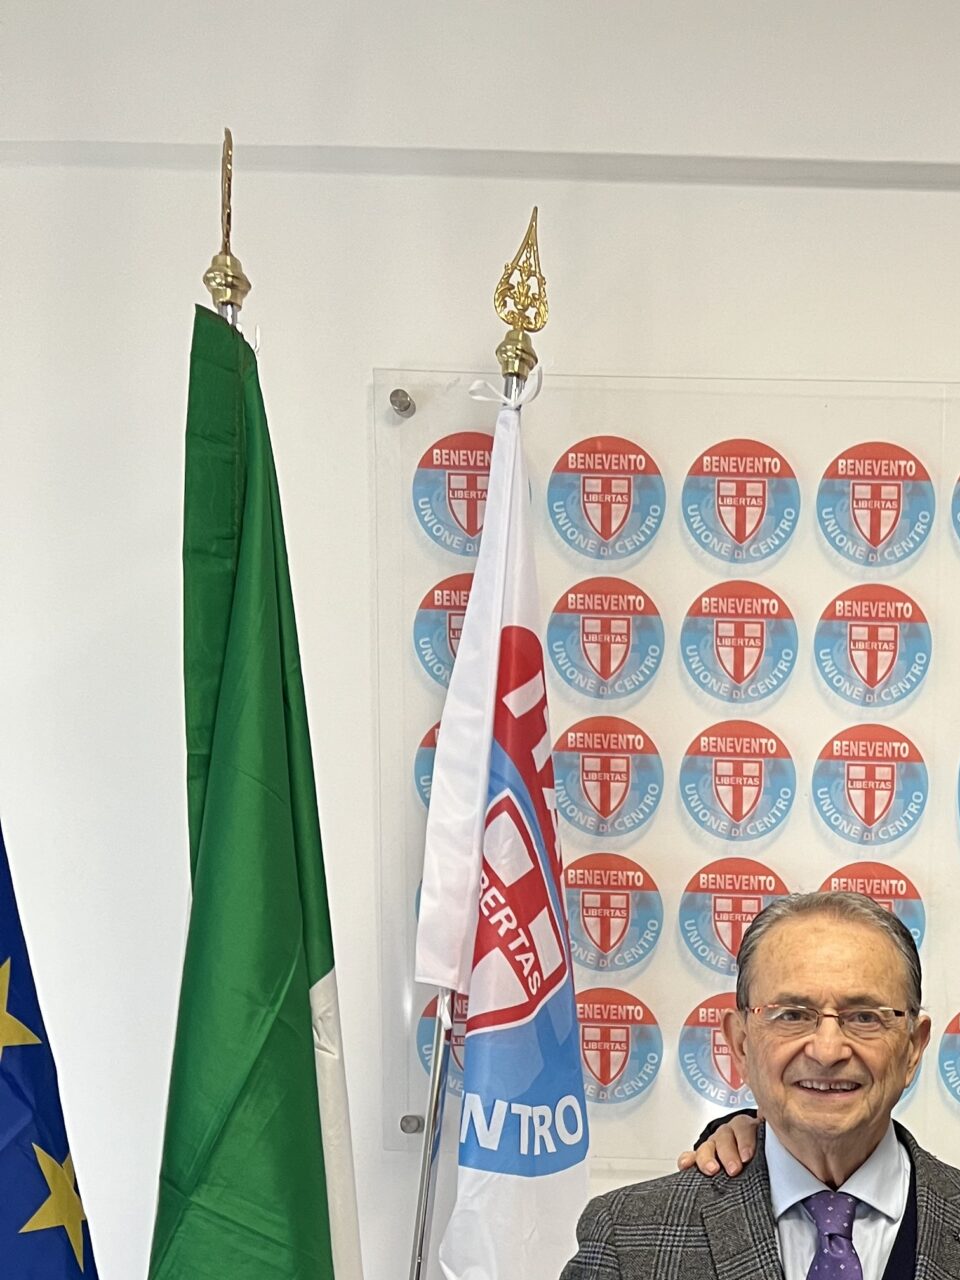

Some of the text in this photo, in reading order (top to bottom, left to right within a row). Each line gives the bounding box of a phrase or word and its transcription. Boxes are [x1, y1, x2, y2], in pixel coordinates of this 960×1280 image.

[433, 449, 493, 466] BENEVEN
[567, 453, 646, 471] BENEVENTO
[702, 456, 781, 474] BENEVENTO
[837, 459, 916, 477] BENEVENTO
[449, 490, 488, 499] LIBERTA
[583, 493, 629, 503] LIBERTAS
[717, 496, 763, 507] LIBERTAS
[852, 499, 898, 510] LIBERTAS
[553, 501, 597, 552] UNIONE
[615, 504, 661, 554] CENTRO
[822, 507, 865, 559] UNIONE
[883, 511, 930, 561] CENTRO
[567, 594, 644, 611] BENEVENTO
[701, 597, 779, 615] BENEVENTO
[835, 601, 913, 618] BENEVENTO
[583, 633, 628, 643] LIBERTAS
[716, 637, 761, 647] LIBERTAS
[850, 641, 895, 651] LIBERTAS
[686, 645, 729, 695] UNIONE
[747, 648, 793, 697] CENTRO
[567, 732, 644, 750] BENEVENTO
[699, 737, 777, 754] BENEVENTO
[832, 741, 909, 758] BENEVENTO
[583, 772, 627, 781] LIBERTAS
[715, 776, 760, 786] LIBERTAS
[847, 780, 892, 790] LIBERTAS
[817, 787, 860, 837] UNIONE
[878, 791, 924, 839] CENTRO
[567, 869, 644, 887] BENEVENTO
[699, 873, 776, 891] BENEVENTO
[831, 877, 907, 895] BENEVENTO
[583, 908, 627, 917] LIBERTAS
[577, 1004, 644, 1020] ENEVENTO
[583, 1042, 627, 1051] LIBERTAS
[460, 1090, 584, 1156] NTRO
